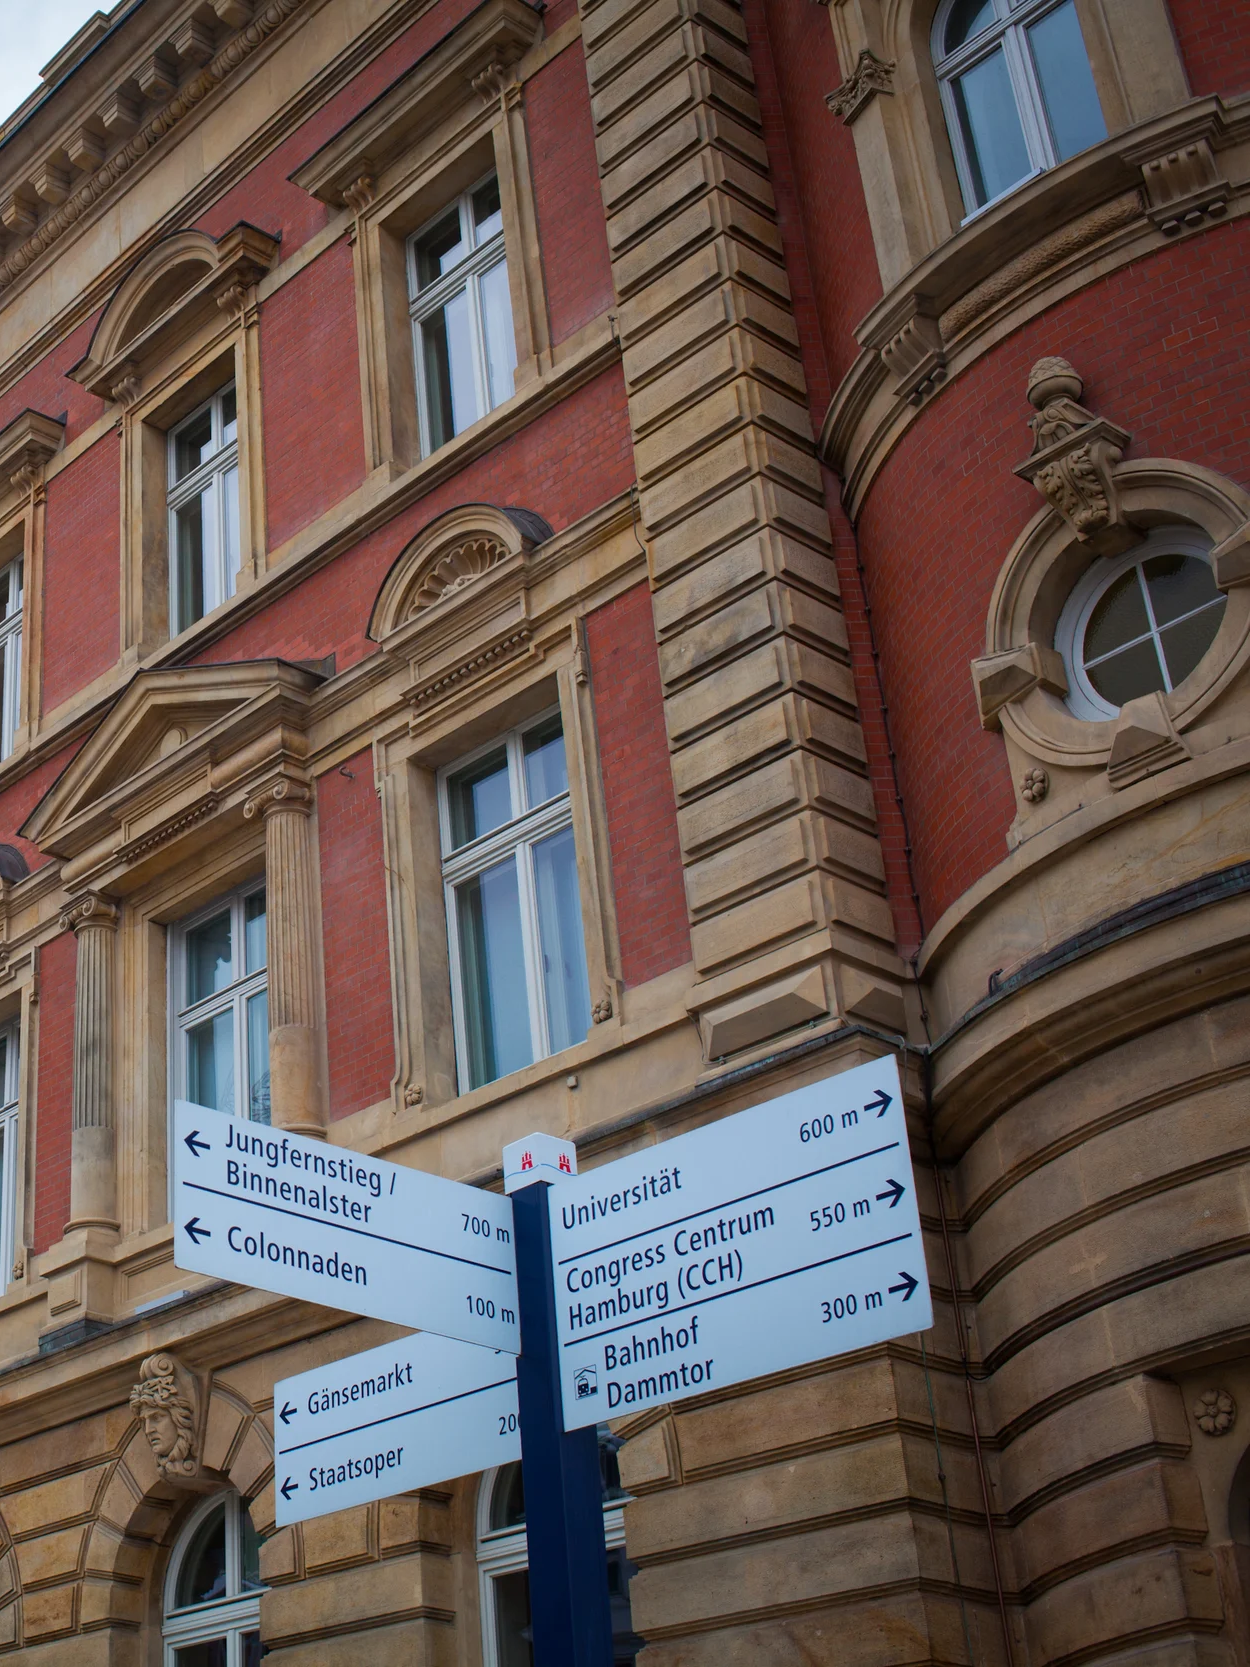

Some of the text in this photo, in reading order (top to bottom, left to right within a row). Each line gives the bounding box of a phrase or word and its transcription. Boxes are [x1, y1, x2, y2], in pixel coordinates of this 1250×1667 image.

[225, 1124, 396, 1197] Jungfernstieg /
[226, 1159, 372, 1223] Binnenalster
[562, 1108, 859, 1230] Universität 600 m
[461, 1213, 510, 1244] 700 m
[809, 1198, 871, 1232] 550 m
[227, 1226, 516, 1325] Colonnaden 100 m
[566, 1206, 775, 1293] Congress Centrum
[568, 1249, 743, 1331] Hamburg (CCH)
[820, 1291, 883, 1324] 300 m
[604, 1315, 699, 1372] Bahnhof
[307, 1362, 413, 1415] Gänsemarkt
[606, 1358, 714, 1409] Dammtor
[308, 1413, 520, 1492] Staatsoper 20
